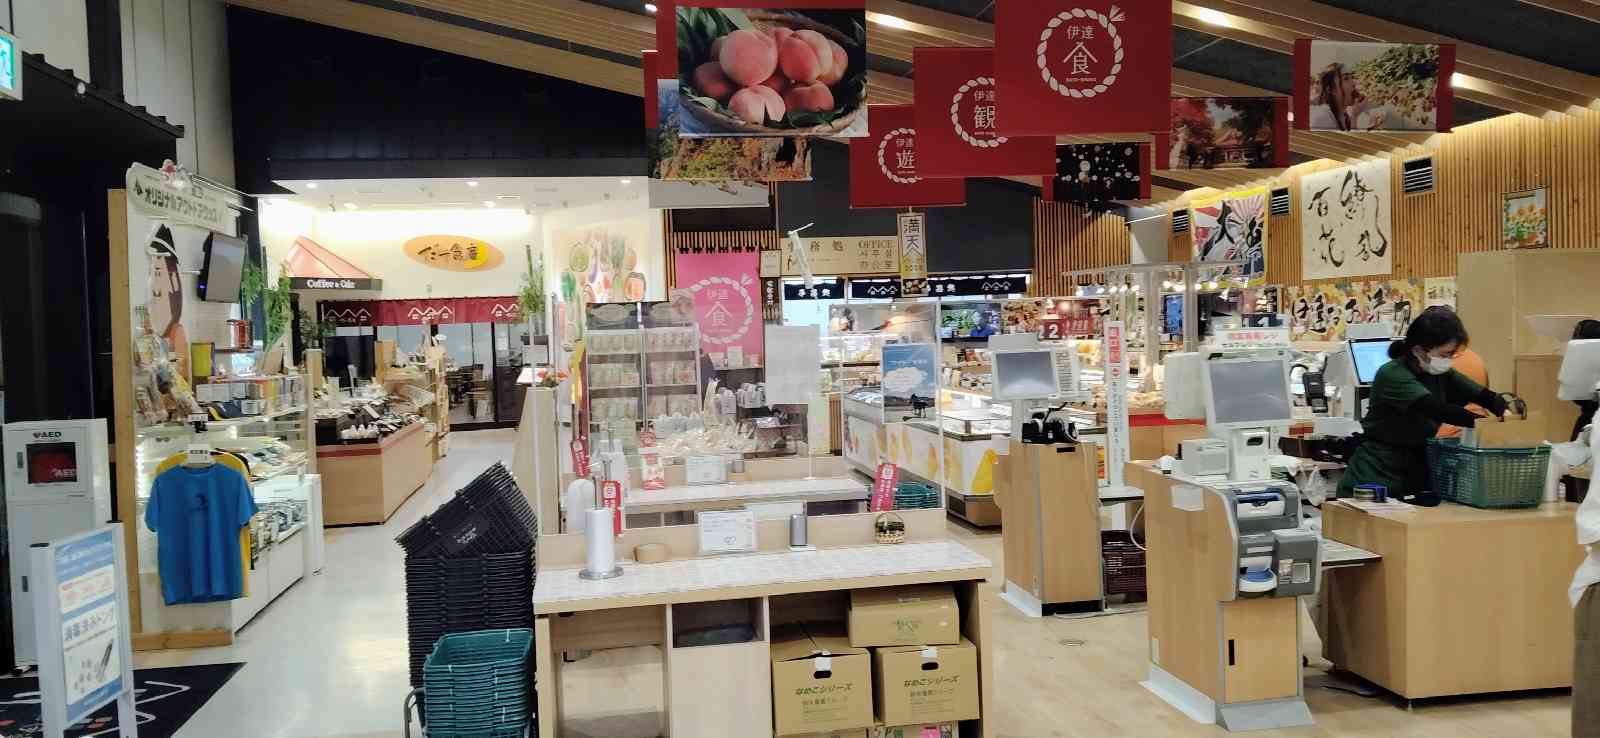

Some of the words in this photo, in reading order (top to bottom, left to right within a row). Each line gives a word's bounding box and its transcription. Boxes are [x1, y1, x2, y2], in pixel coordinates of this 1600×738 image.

[1067, 25, 1097, 40] 伊達
[1063, 41, 1099, 75] 食
[974, 105, 997, 129] 観
[896, 150, 915, 169] 遊
[858, 240, 894, 249] OFFICE
[306, 279, 335, 289] Coffee
[706, 288, 729, 300] 伊達
[705, 301, 734, 327] 食
[904, 675, 960, 688] なめこシリーズ
[795, 683, 854, 696] なめこシリーズ
